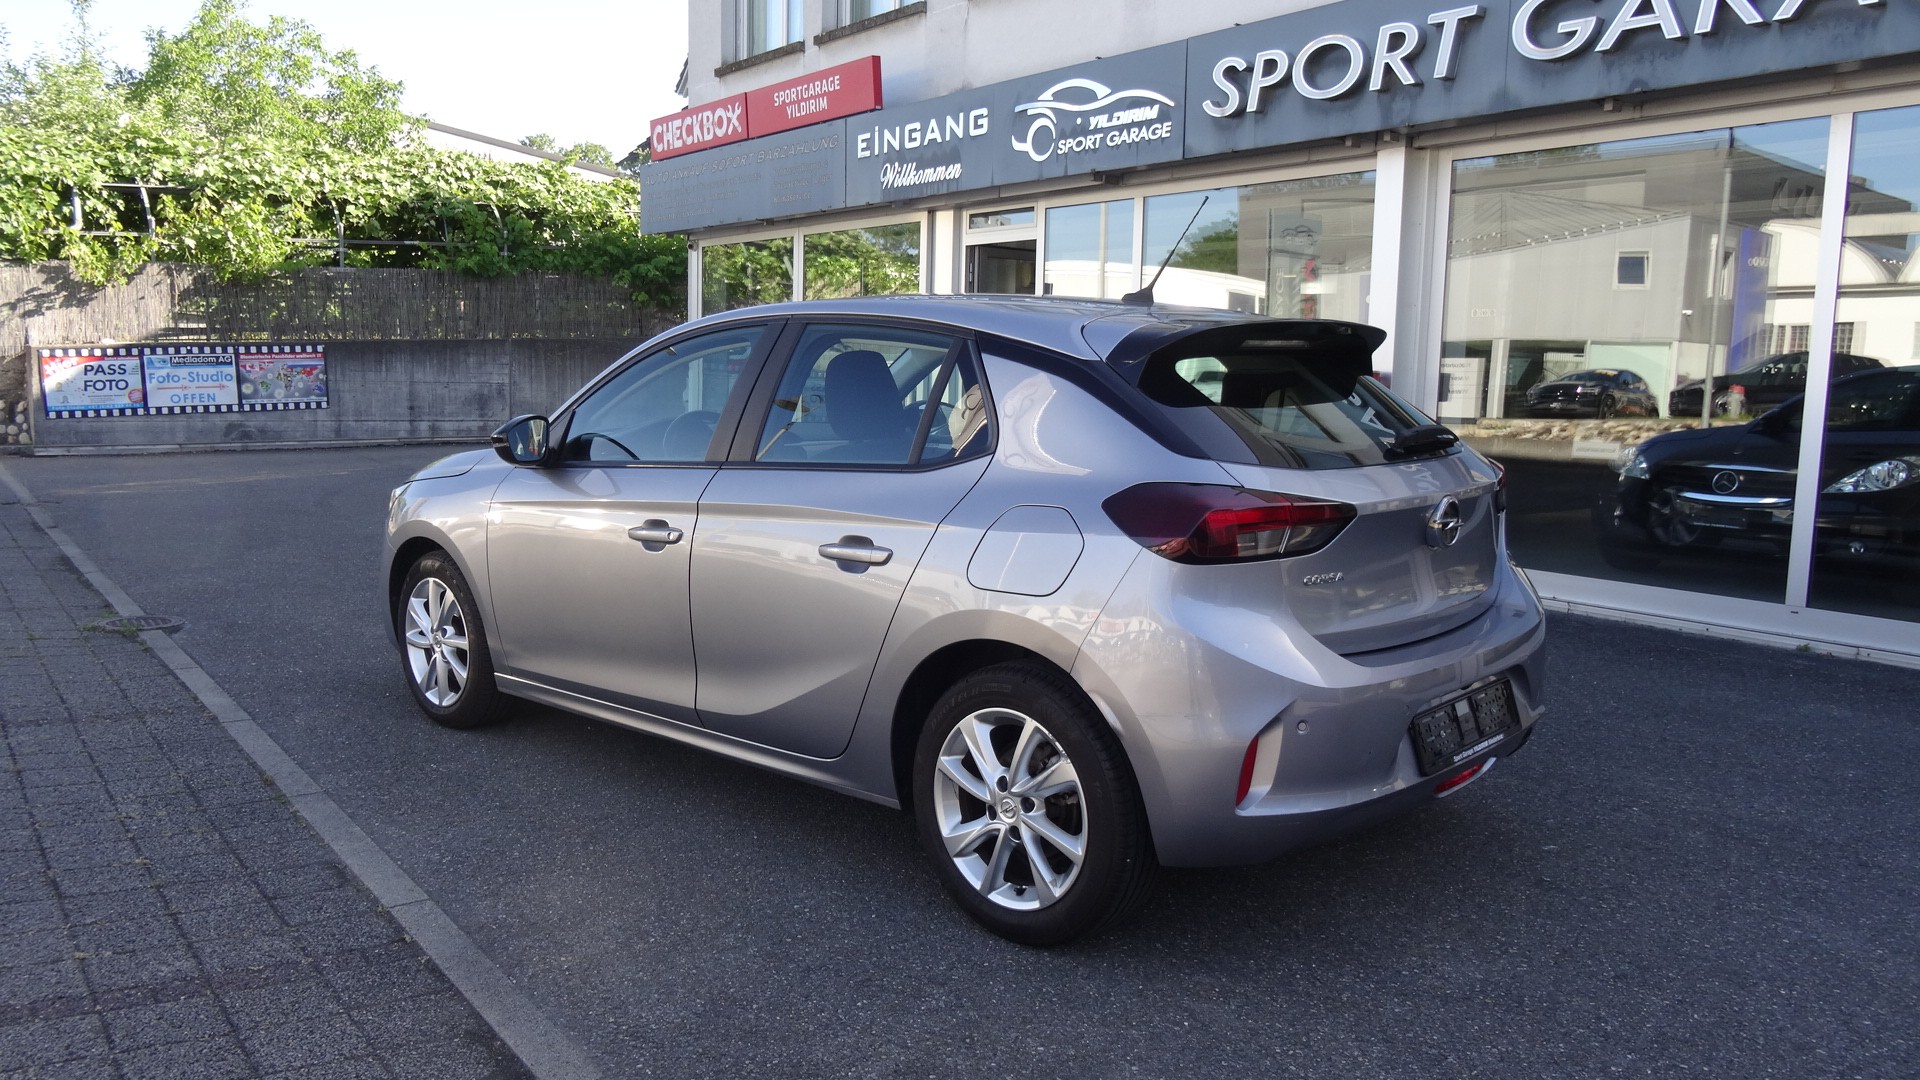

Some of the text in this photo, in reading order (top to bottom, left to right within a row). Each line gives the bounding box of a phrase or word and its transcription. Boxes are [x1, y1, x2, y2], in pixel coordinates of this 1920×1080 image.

[1201, 0, 1880, 119] SPORT GA
[773, 75, 841, 107] SPORTGARAGE
[786, 96, 828, 119] YILDIRIM
[1089, 104, 1160, 130] YILDIRIM
[652, 101, 742, 153] CHECKBOX
[1056, 121, 1172, 155] SPORT GARAGE
[711, 153, 753, 173] SOFORT
[757, 135, 839, 163] BARZAHLUNG
[880, 161, 962, 190] Willkommen
[83, 363, 127, 376] PASS
[171, 356, 232, 364] Mediadom AG
[83, 379, 129, 392] FOTO
[148, 370, 234, 384] Foto-Studio
[170, 393, 216, 404] OFFEN
[1303, 572, 1345, 586] CORSA
